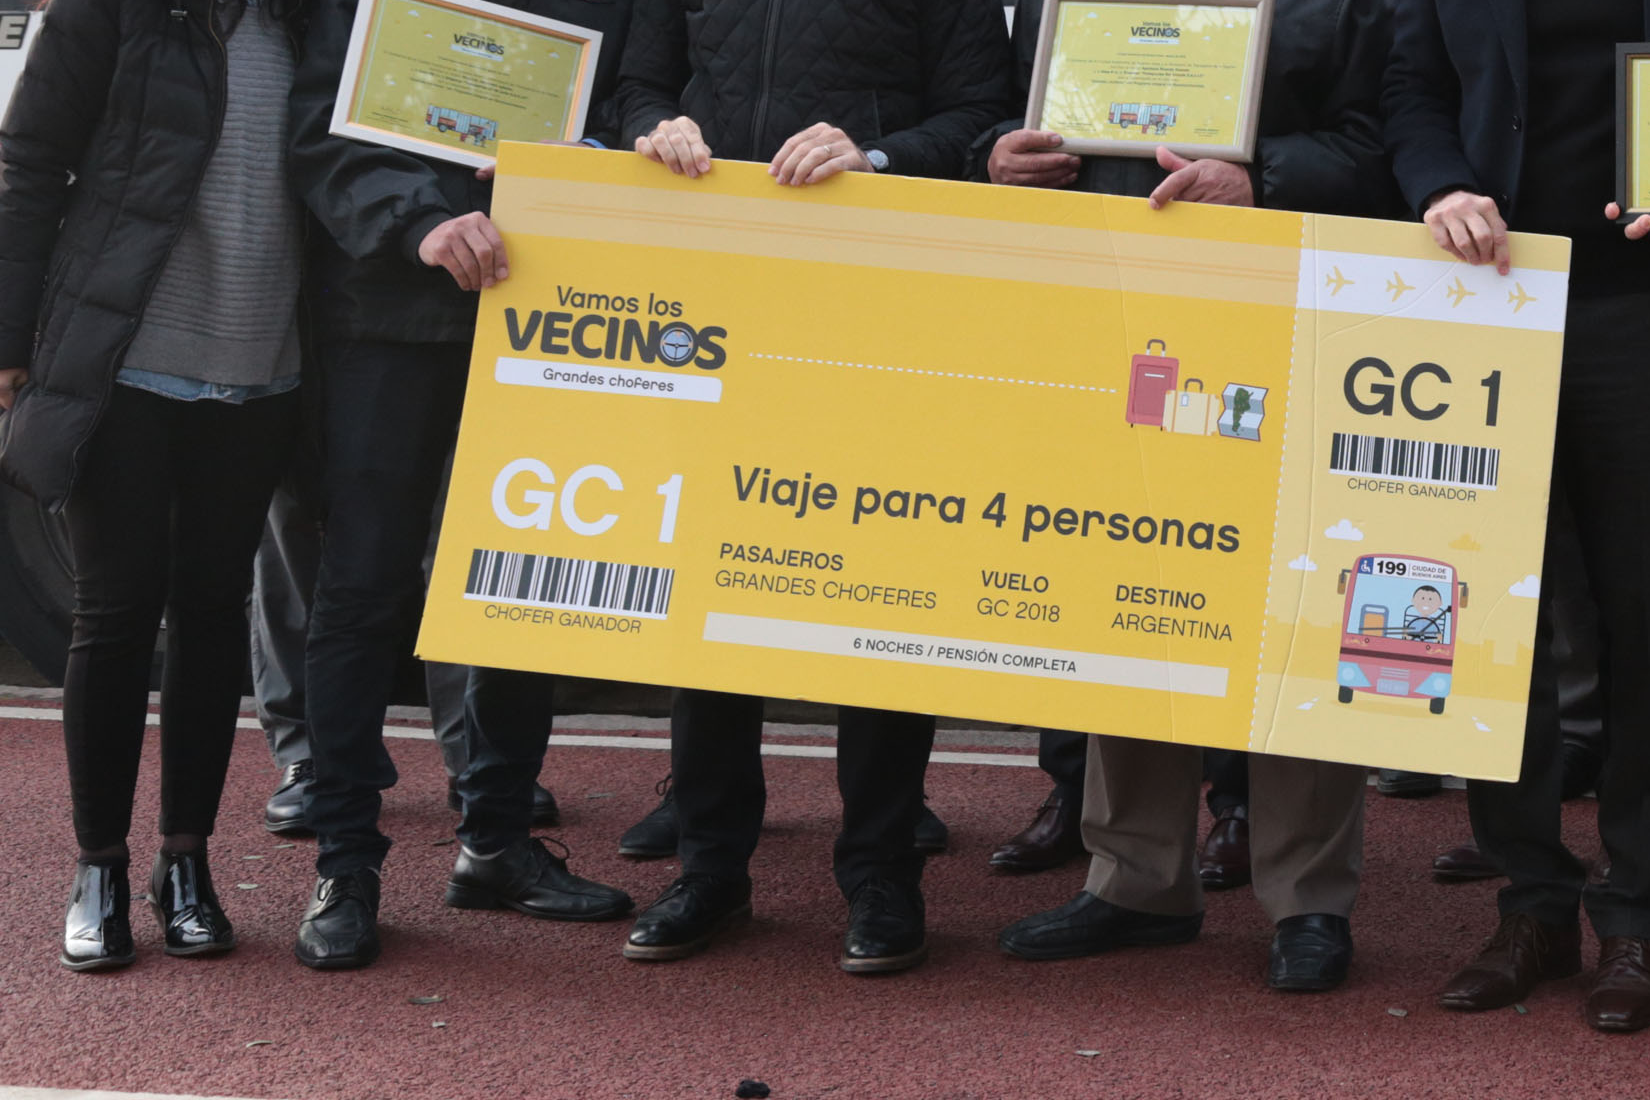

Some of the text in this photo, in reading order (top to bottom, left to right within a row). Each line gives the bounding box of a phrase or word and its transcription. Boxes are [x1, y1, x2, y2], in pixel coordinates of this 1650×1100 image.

[1131, 26, 1180, 38] VECINOS
[557, 285, 683, 317] Vamos los
[504, 307, 728, 370] VECINOS
[543, 368, 674, 392] Grandes choferes
[1343, 356, 1501, 426] GC 1
[491, 457, 684, 543] GC 1
[1347, 478, 1477, 502] CHOFER GANADOR
[733, 465, 1240, 553] Viaje para 4 personas
[719, 542, 844, 572] PASAJEROS
[1377, 560, 1407, 576] 199
[1412, 565, 1436, 573] CIUDAD
[715, 570, 937, 609] GRANDES CHOFERES
[981, 570, 1049, 593] VUELO
[977, 598, 1060, 623] GC 2018
[1116, 585, 1206, 610] DESTINO
[484, 604, 642, 634] CHOFER GANADOR
[1111, 612, 1232, 642] ARGENTINA
[853, 637, 862, 649] 6
[866, 639, 924, 656] NOCHES
[937, 645, 998, 664] PENSIÓN
[1002, 653, 1077, 673] COMPLETA
